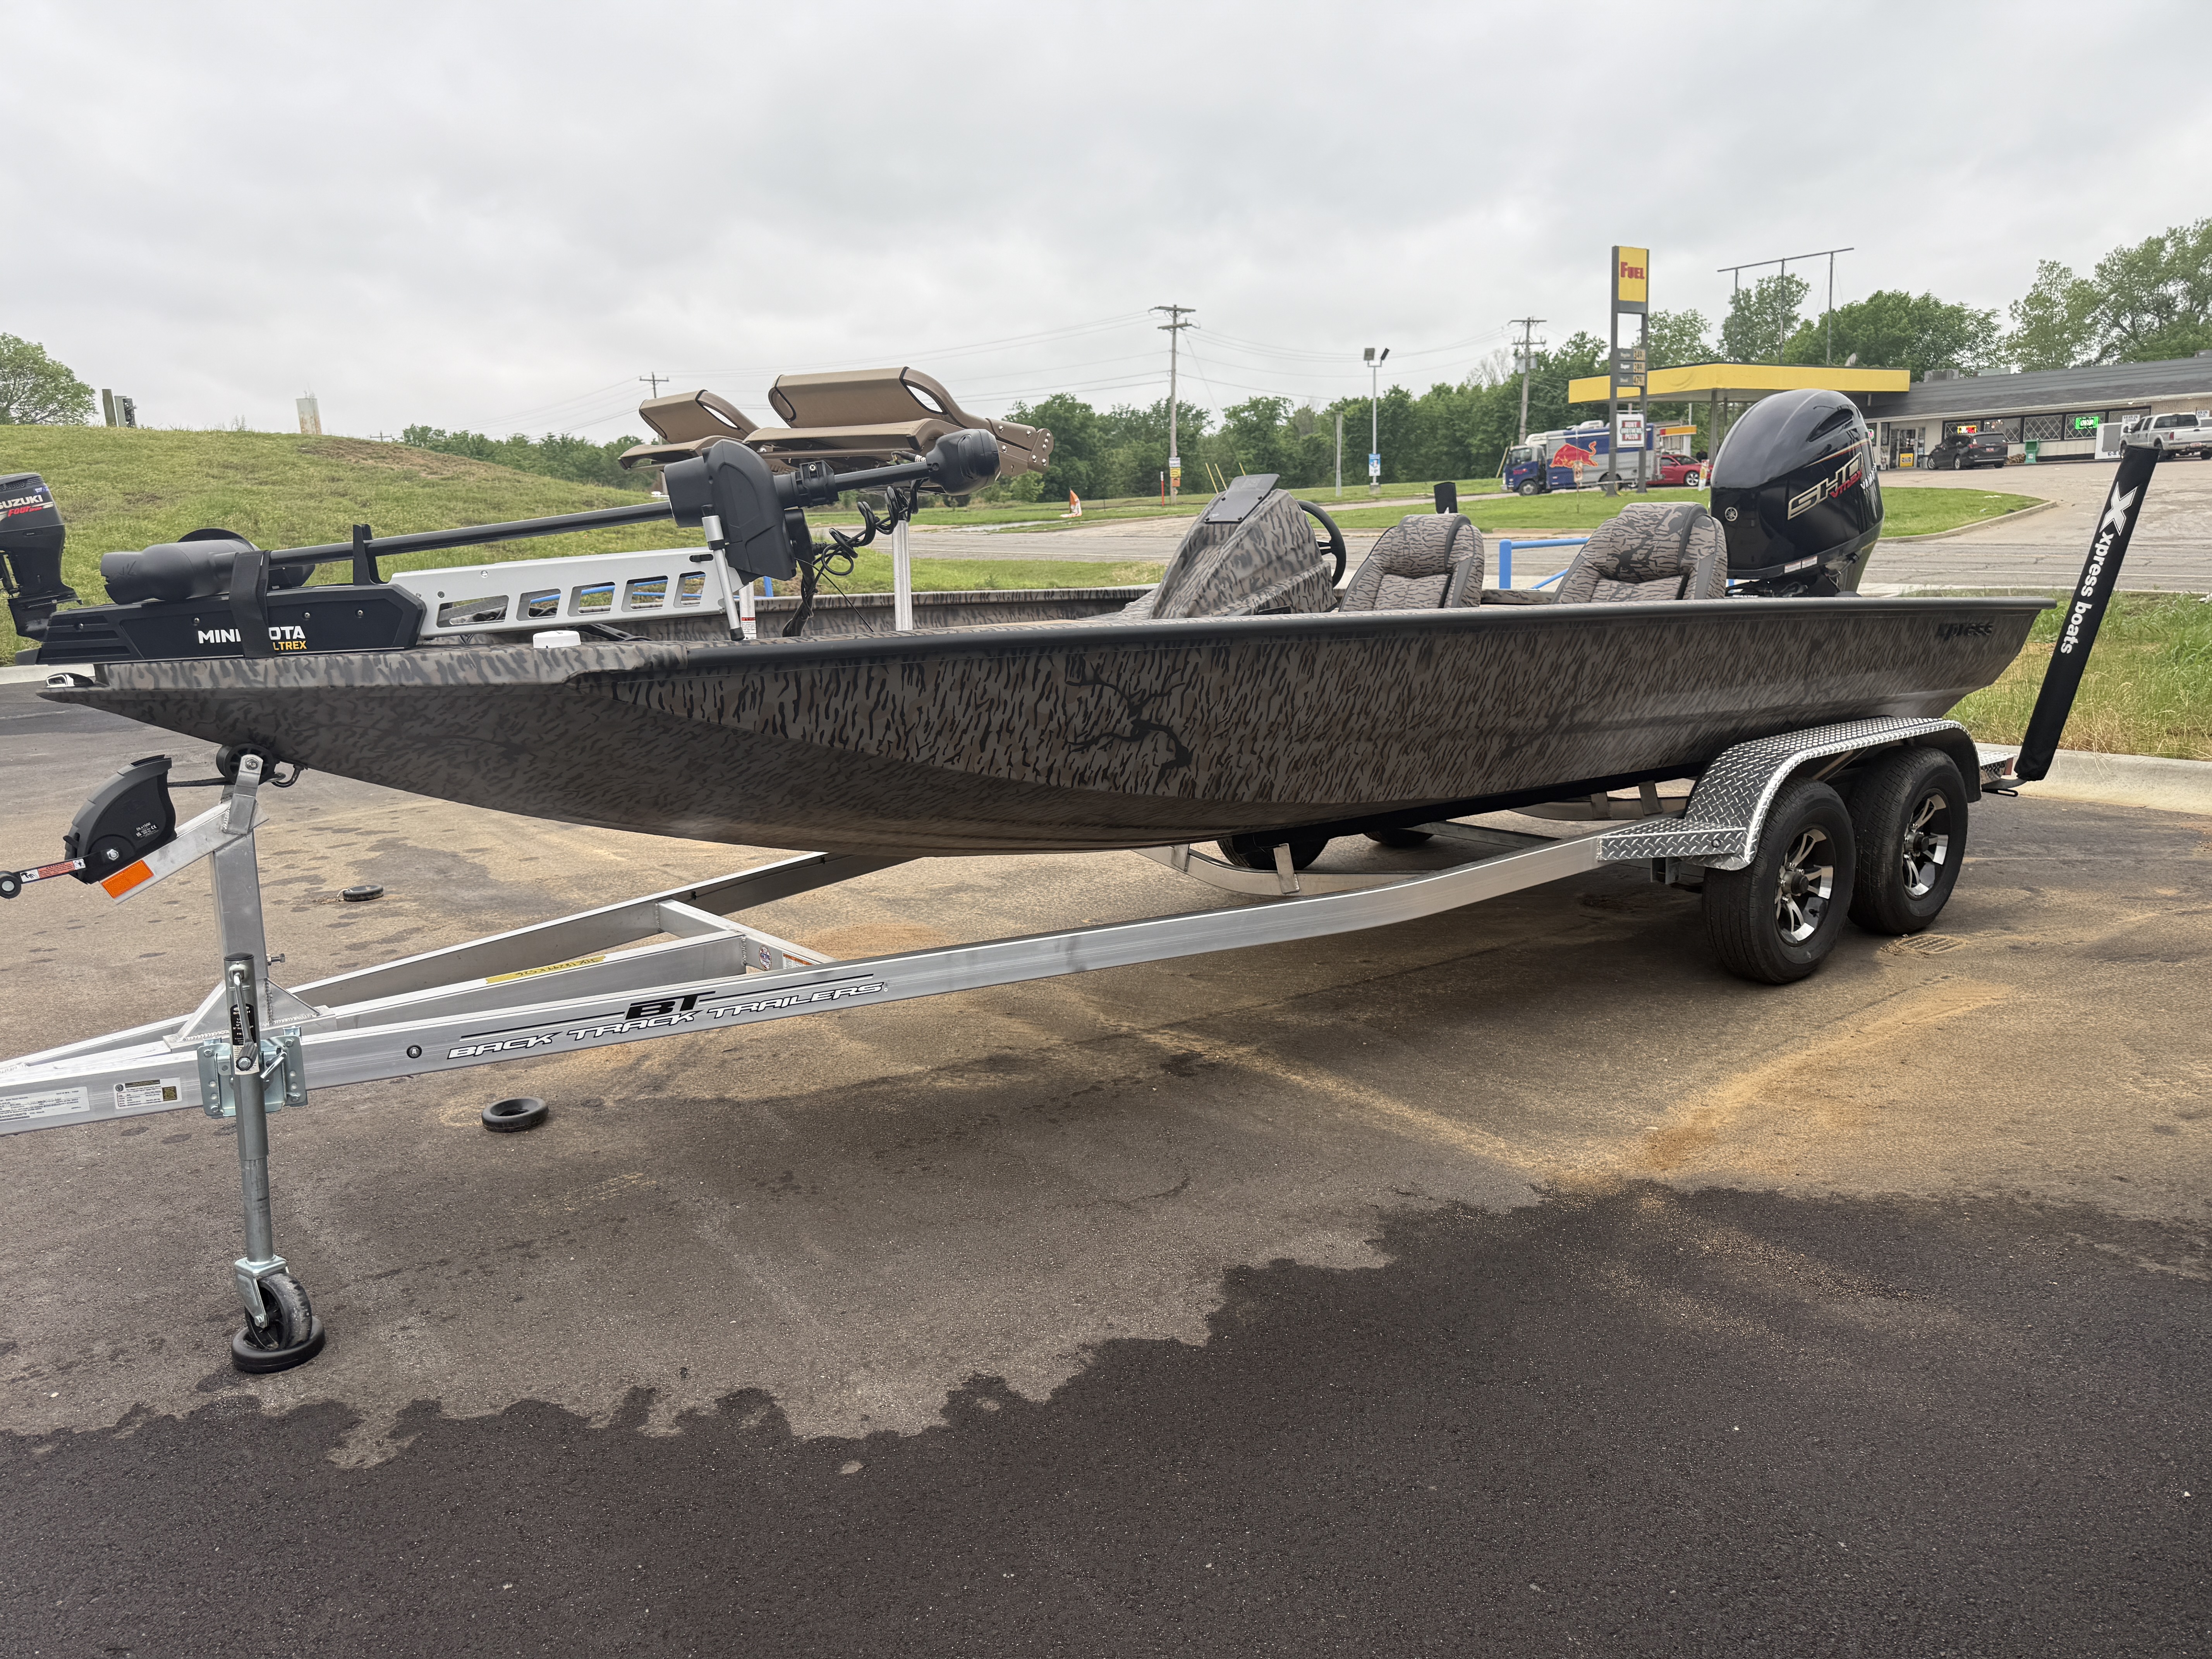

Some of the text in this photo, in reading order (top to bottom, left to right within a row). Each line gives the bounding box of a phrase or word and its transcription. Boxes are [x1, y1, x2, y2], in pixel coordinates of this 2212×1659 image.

[1621, 261, 1645, 279] FUEL
[2061, 531, 2114, 654] xpress boats
[268, 626, 306, 640] OTA
[273, 641, 307, 651] LTREX
[625, 991, 716, 1020] BT
[447, 982, 884, 1060] BACK TRACK TRAILERS
